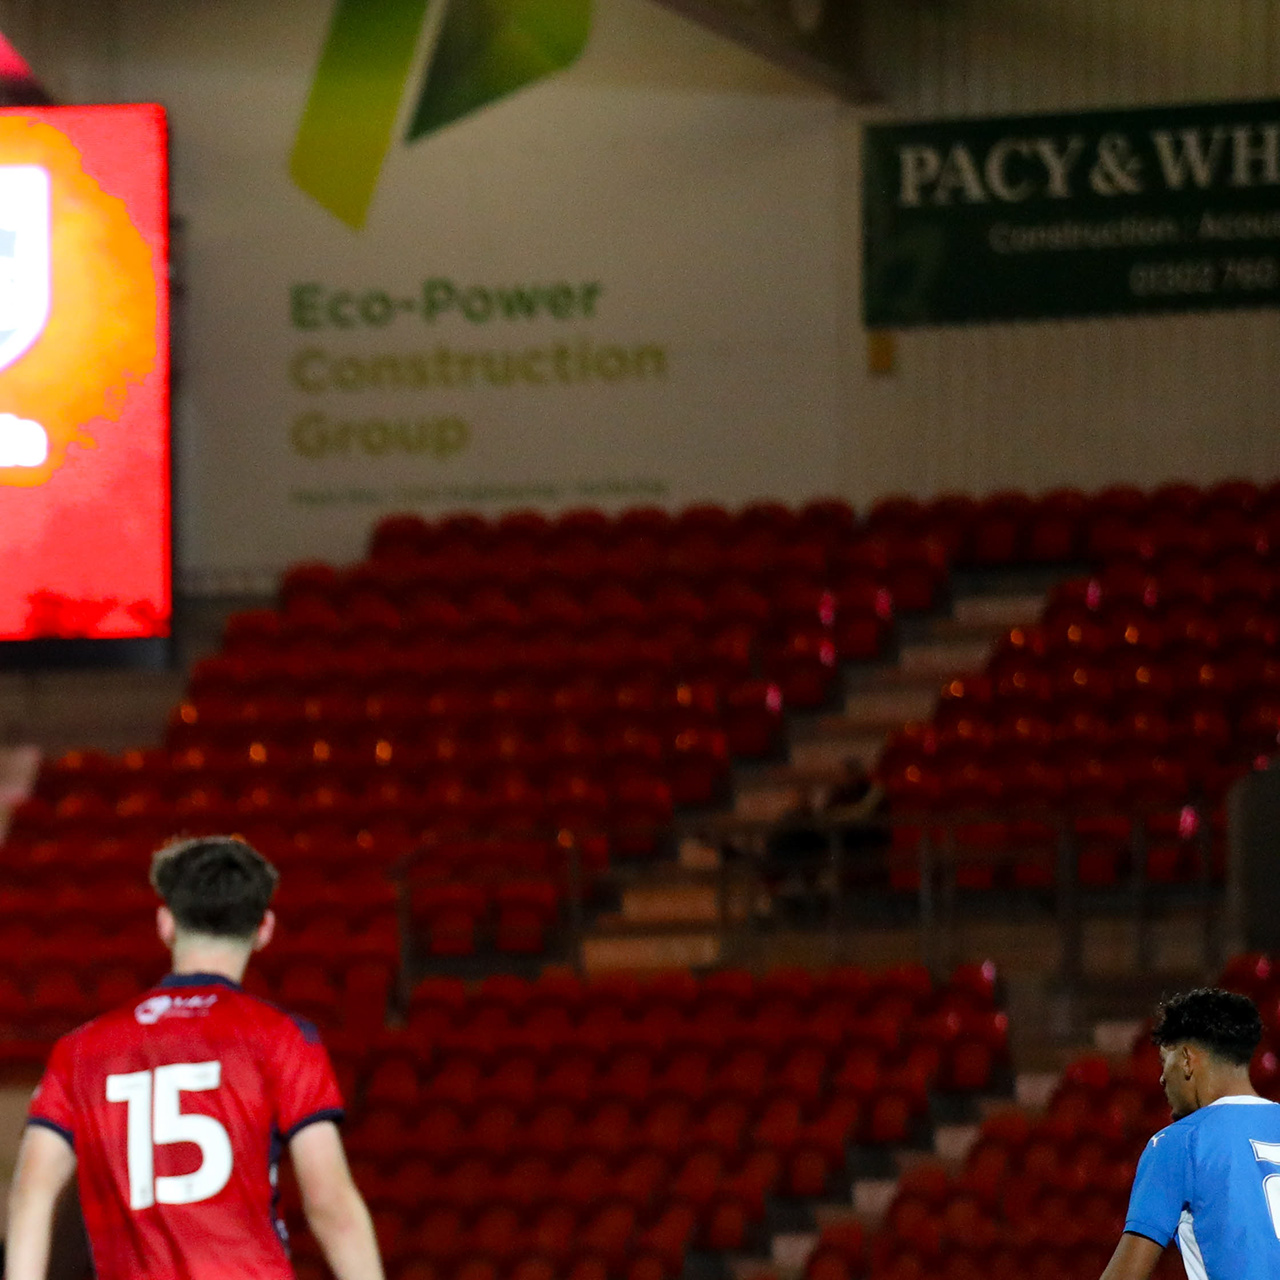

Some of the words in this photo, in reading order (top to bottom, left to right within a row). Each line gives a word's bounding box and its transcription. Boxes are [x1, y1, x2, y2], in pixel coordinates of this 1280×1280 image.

[898, 133, 1086, 208] PACY
[1089, 130, 1146, 197] &
[289, 276, 602, 331] Eco-Power
[288, 337, 669, 396] Construction
[289, 409, 471, 462] Group
[105, 1059, 234, 1211] 15
